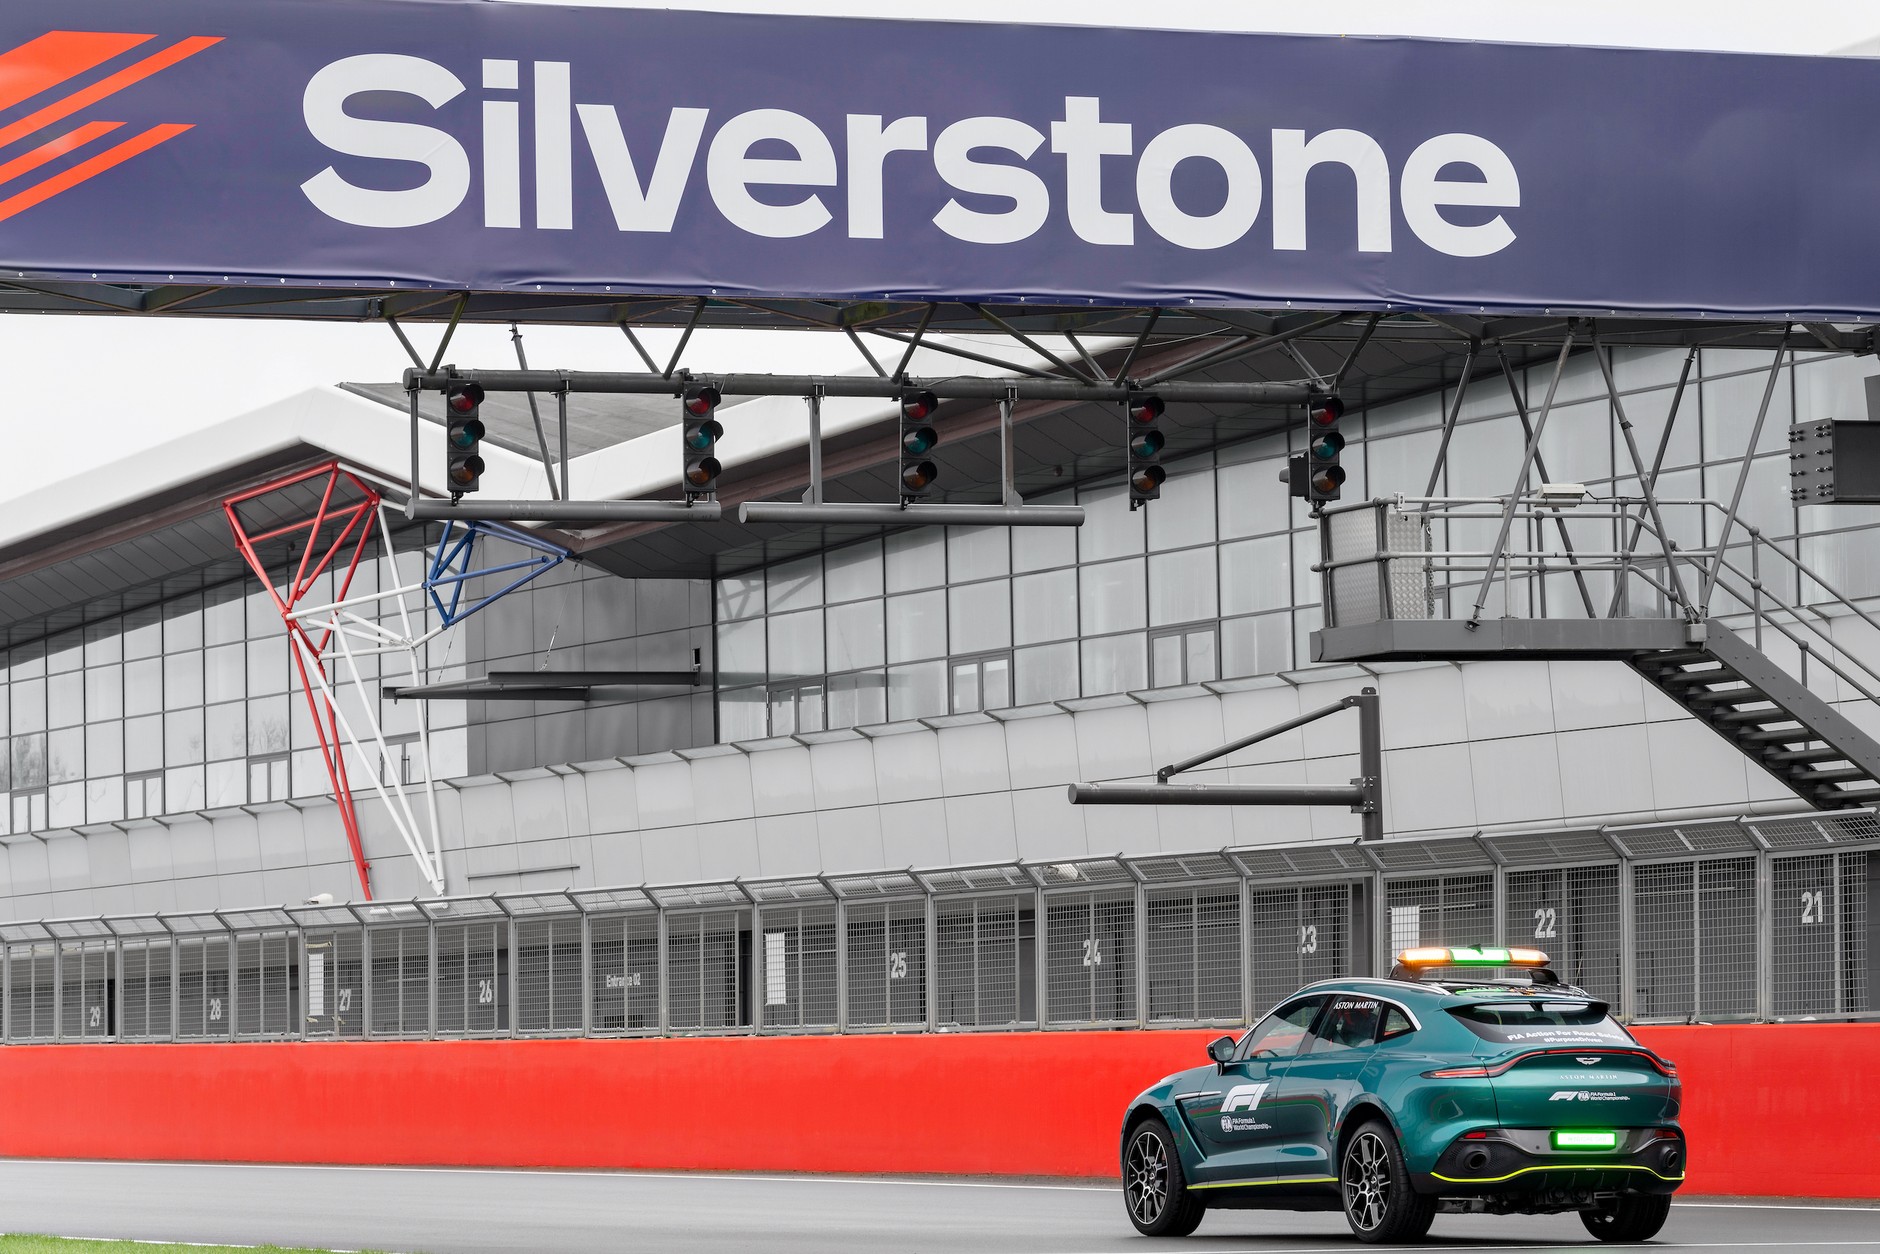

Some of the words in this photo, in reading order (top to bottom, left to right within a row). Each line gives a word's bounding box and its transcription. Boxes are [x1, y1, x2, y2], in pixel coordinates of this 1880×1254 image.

[301, 53, 1520, 258] Silverstone
[1801, 891, 1823, 923] 21
[1534, 908, 1556, 939] 22
[1296, 925, 1317, 954] 23
[1083, 939, 1101, 966] 24
[890, 952, 907, 978] 25
[633, 973, 641, 986] 02
[339, 989, 351, 1011] 27
[479, 980, 492, 1003] 26
[90, 1006, 101, 1027] 29
[210, 999, 222, 1020] 28
[1354, 1001, 1379, 1009] MARTIN
[1526, 1030, 1555, 1038] Action
[1220, 1083, 1270, 1112] F1
[1548, 1091, 1578, 1101] F1
